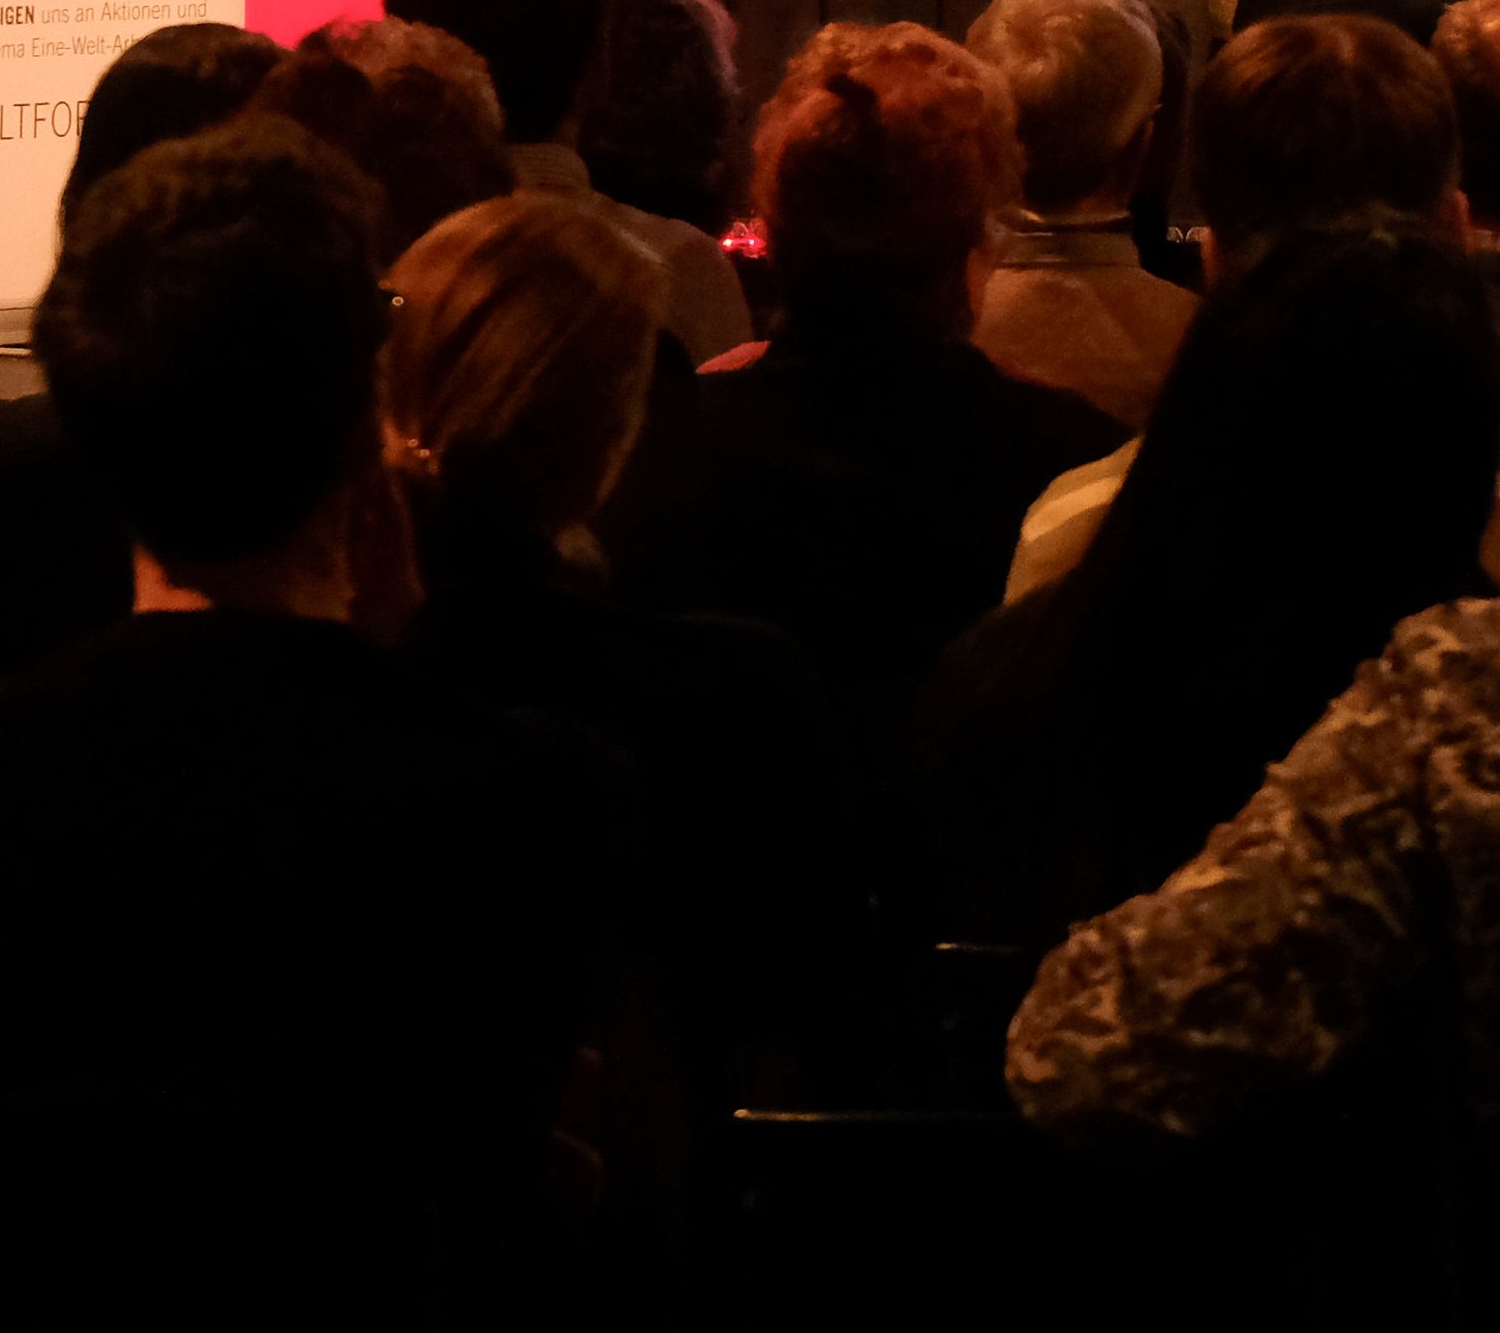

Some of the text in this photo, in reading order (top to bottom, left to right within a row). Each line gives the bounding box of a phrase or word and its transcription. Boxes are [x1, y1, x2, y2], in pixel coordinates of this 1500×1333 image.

[41, 8, 70, 24] uns
[75, 6, 94, 22] an
[101, 1, 171, 21] Aktionen
[177, 0, 207, 19] und
